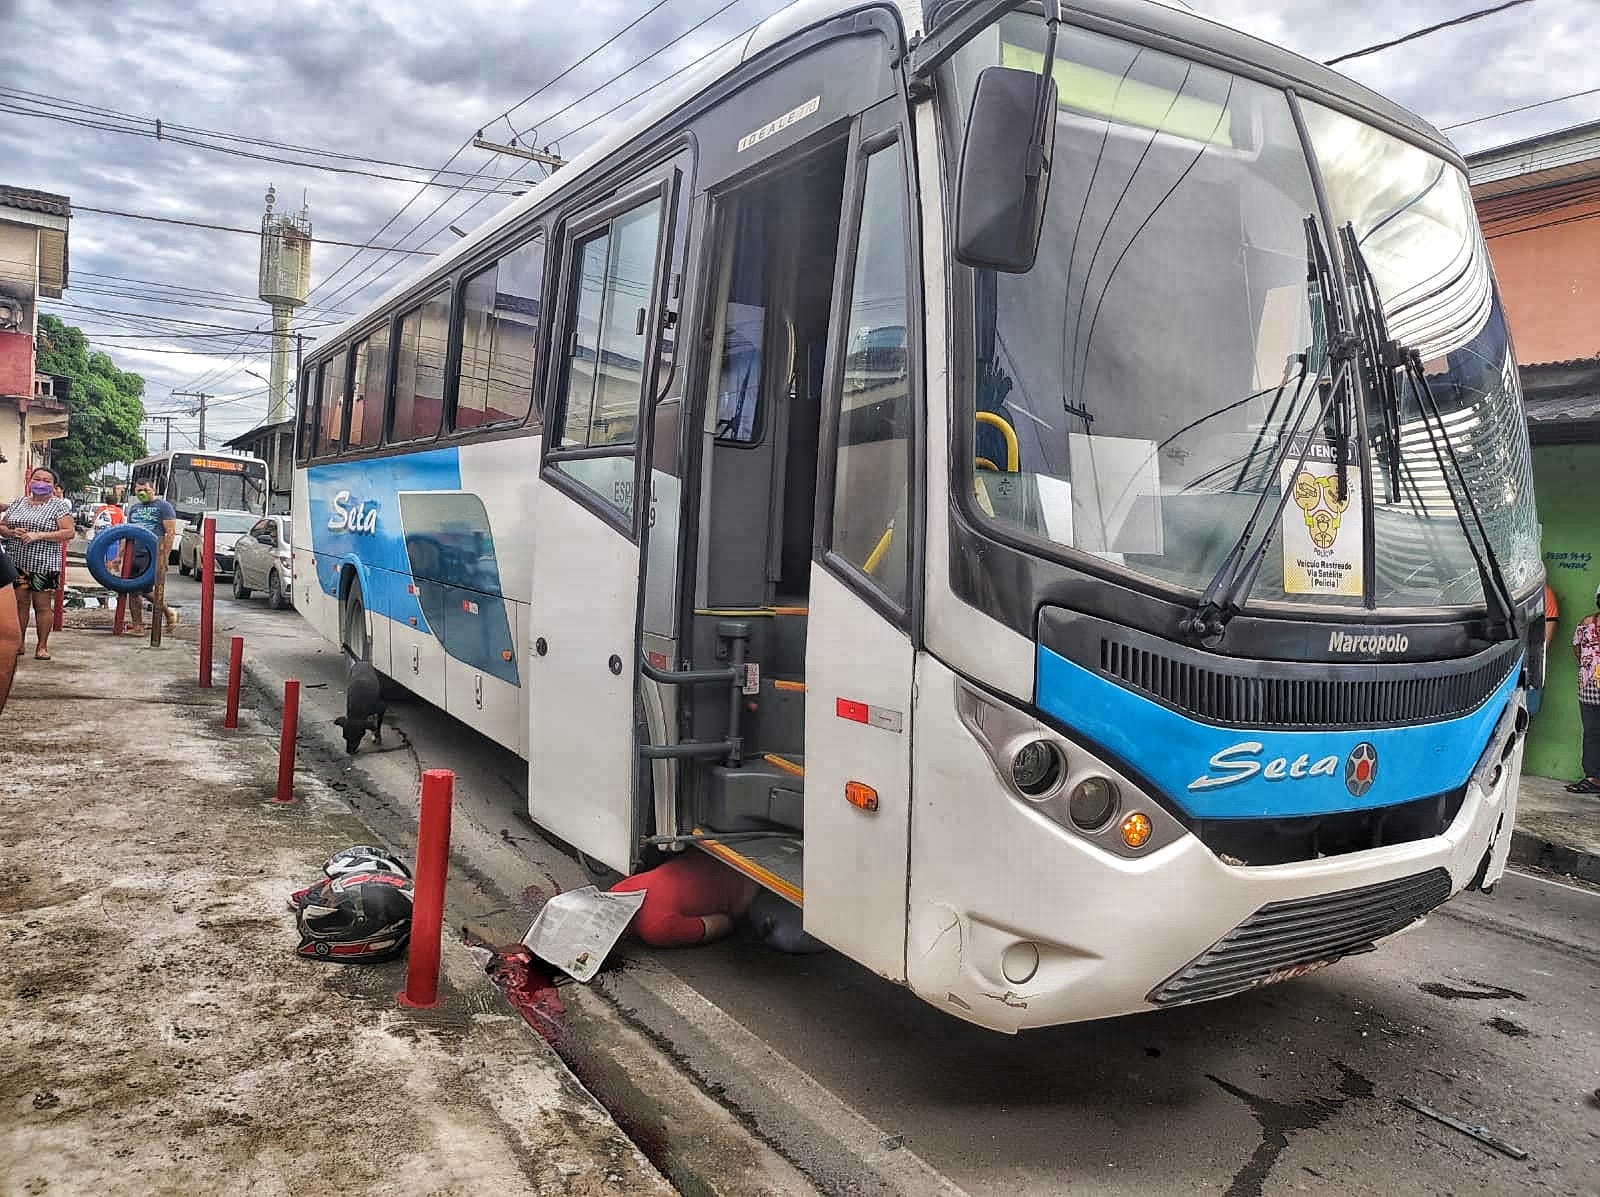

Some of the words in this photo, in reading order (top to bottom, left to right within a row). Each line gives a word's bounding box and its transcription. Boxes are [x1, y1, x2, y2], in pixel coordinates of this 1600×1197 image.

[327, 490, 377, 534] Seta
[1306, 569, 1318, 577] Via
[1318, 569, 1343, 579] Satélite
[1320, 561, 1352, 571] Rastreado
[1327, 631, 1409, 655] Marcopolo
[1187, 741, 1339, 791] Seta
